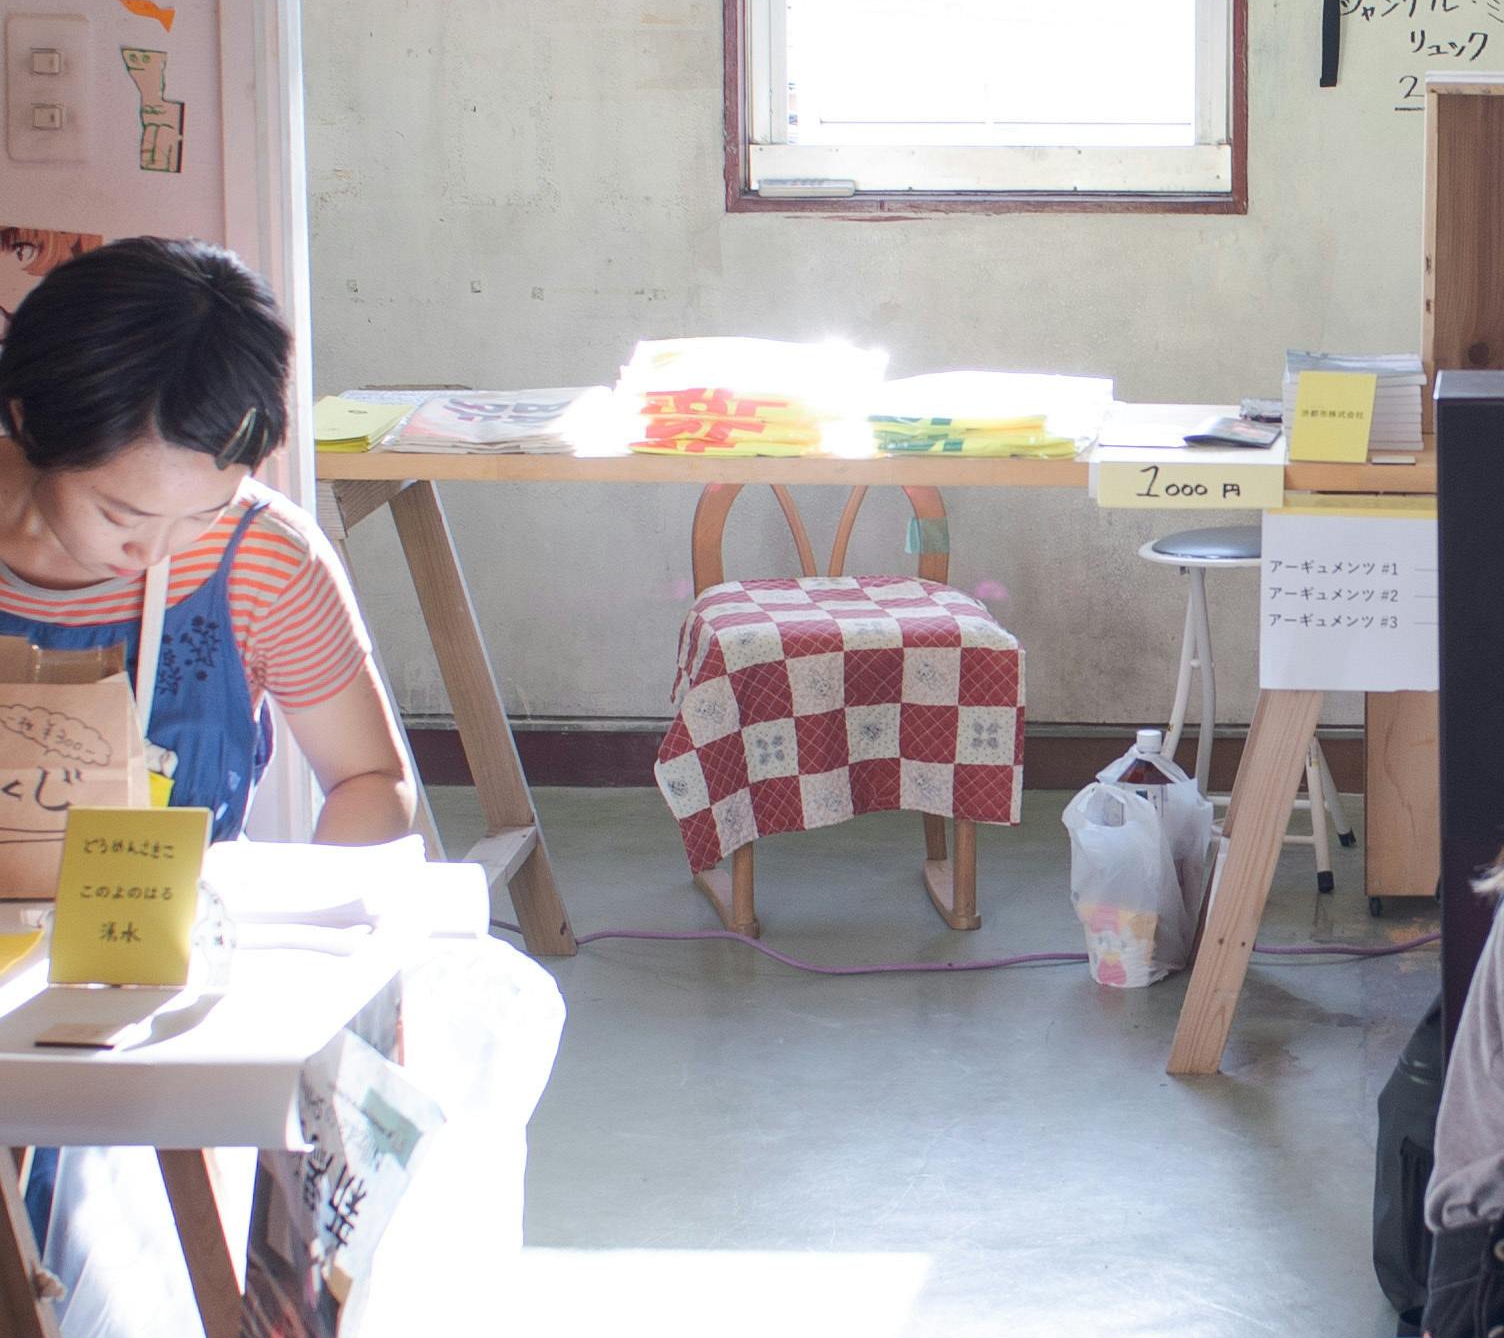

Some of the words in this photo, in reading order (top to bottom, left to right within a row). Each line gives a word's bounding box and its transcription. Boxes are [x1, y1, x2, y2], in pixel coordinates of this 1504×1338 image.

[1409, 28, 1489, 62] リュック
[1269, 560, 1376, 575] アーギュメンツ
[1380, 562, 1399, 576] #1
[1269, 587, 1376, 602] アーギュメンツ
[1380, 589, 1399, 603] #2
[1269, 613, 1376, 628] アーギュメンツ
[1380, 615, 1399, 629] #3
